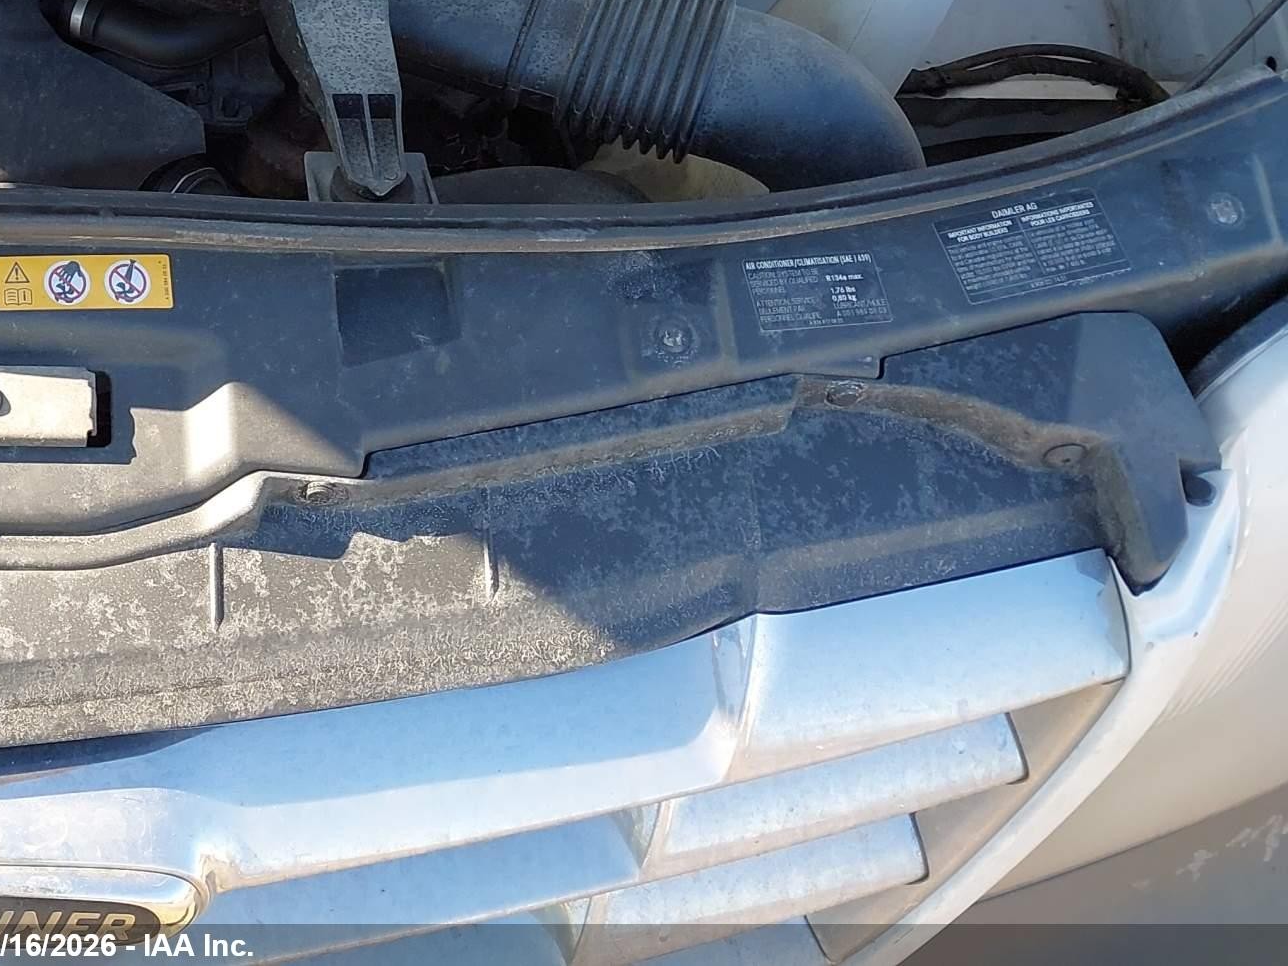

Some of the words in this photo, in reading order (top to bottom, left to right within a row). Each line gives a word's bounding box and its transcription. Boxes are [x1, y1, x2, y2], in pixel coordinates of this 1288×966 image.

[992, 203, 1026, 219] DAIMLER
[1025, 201, 1038, 212] AG
[745, 261, 756, 270] AIR
